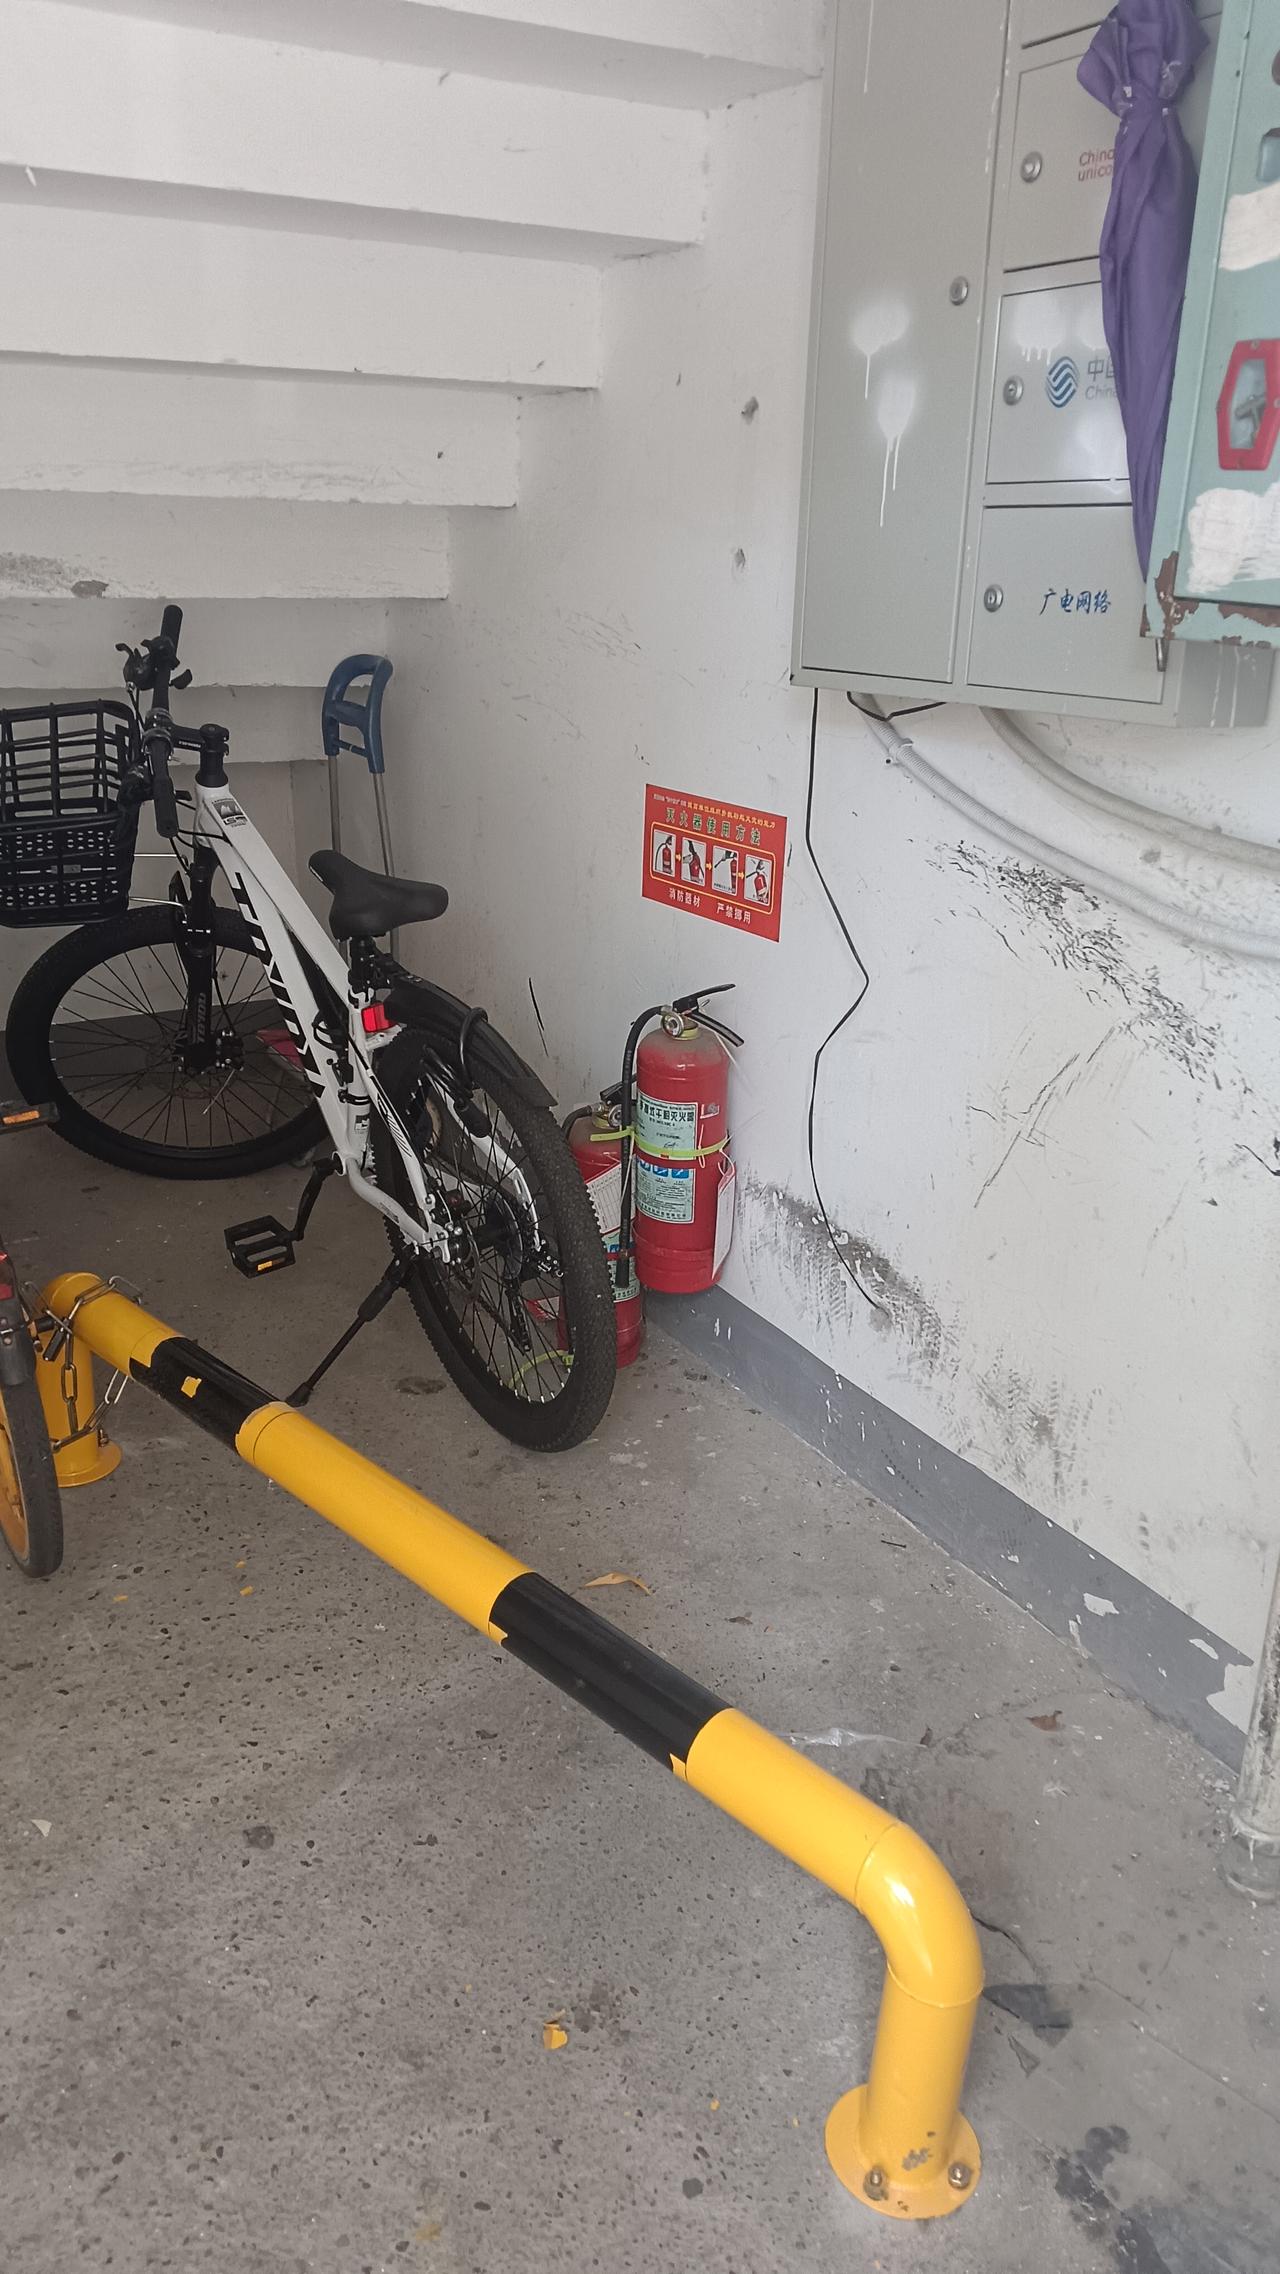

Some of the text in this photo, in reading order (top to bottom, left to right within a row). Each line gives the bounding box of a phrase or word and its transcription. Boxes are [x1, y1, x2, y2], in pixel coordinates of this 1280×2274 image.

[1079, 149, 1116, 167] China
[1078, 164, 1113, 182] unico
[1039, 588, 1112, 616] 广电网络
[665, 806, 761, 846] 灭火器使用方法
[668, 887, 702, 908] 消防器材
[716, 902, 751, 924] 严禁挪用
